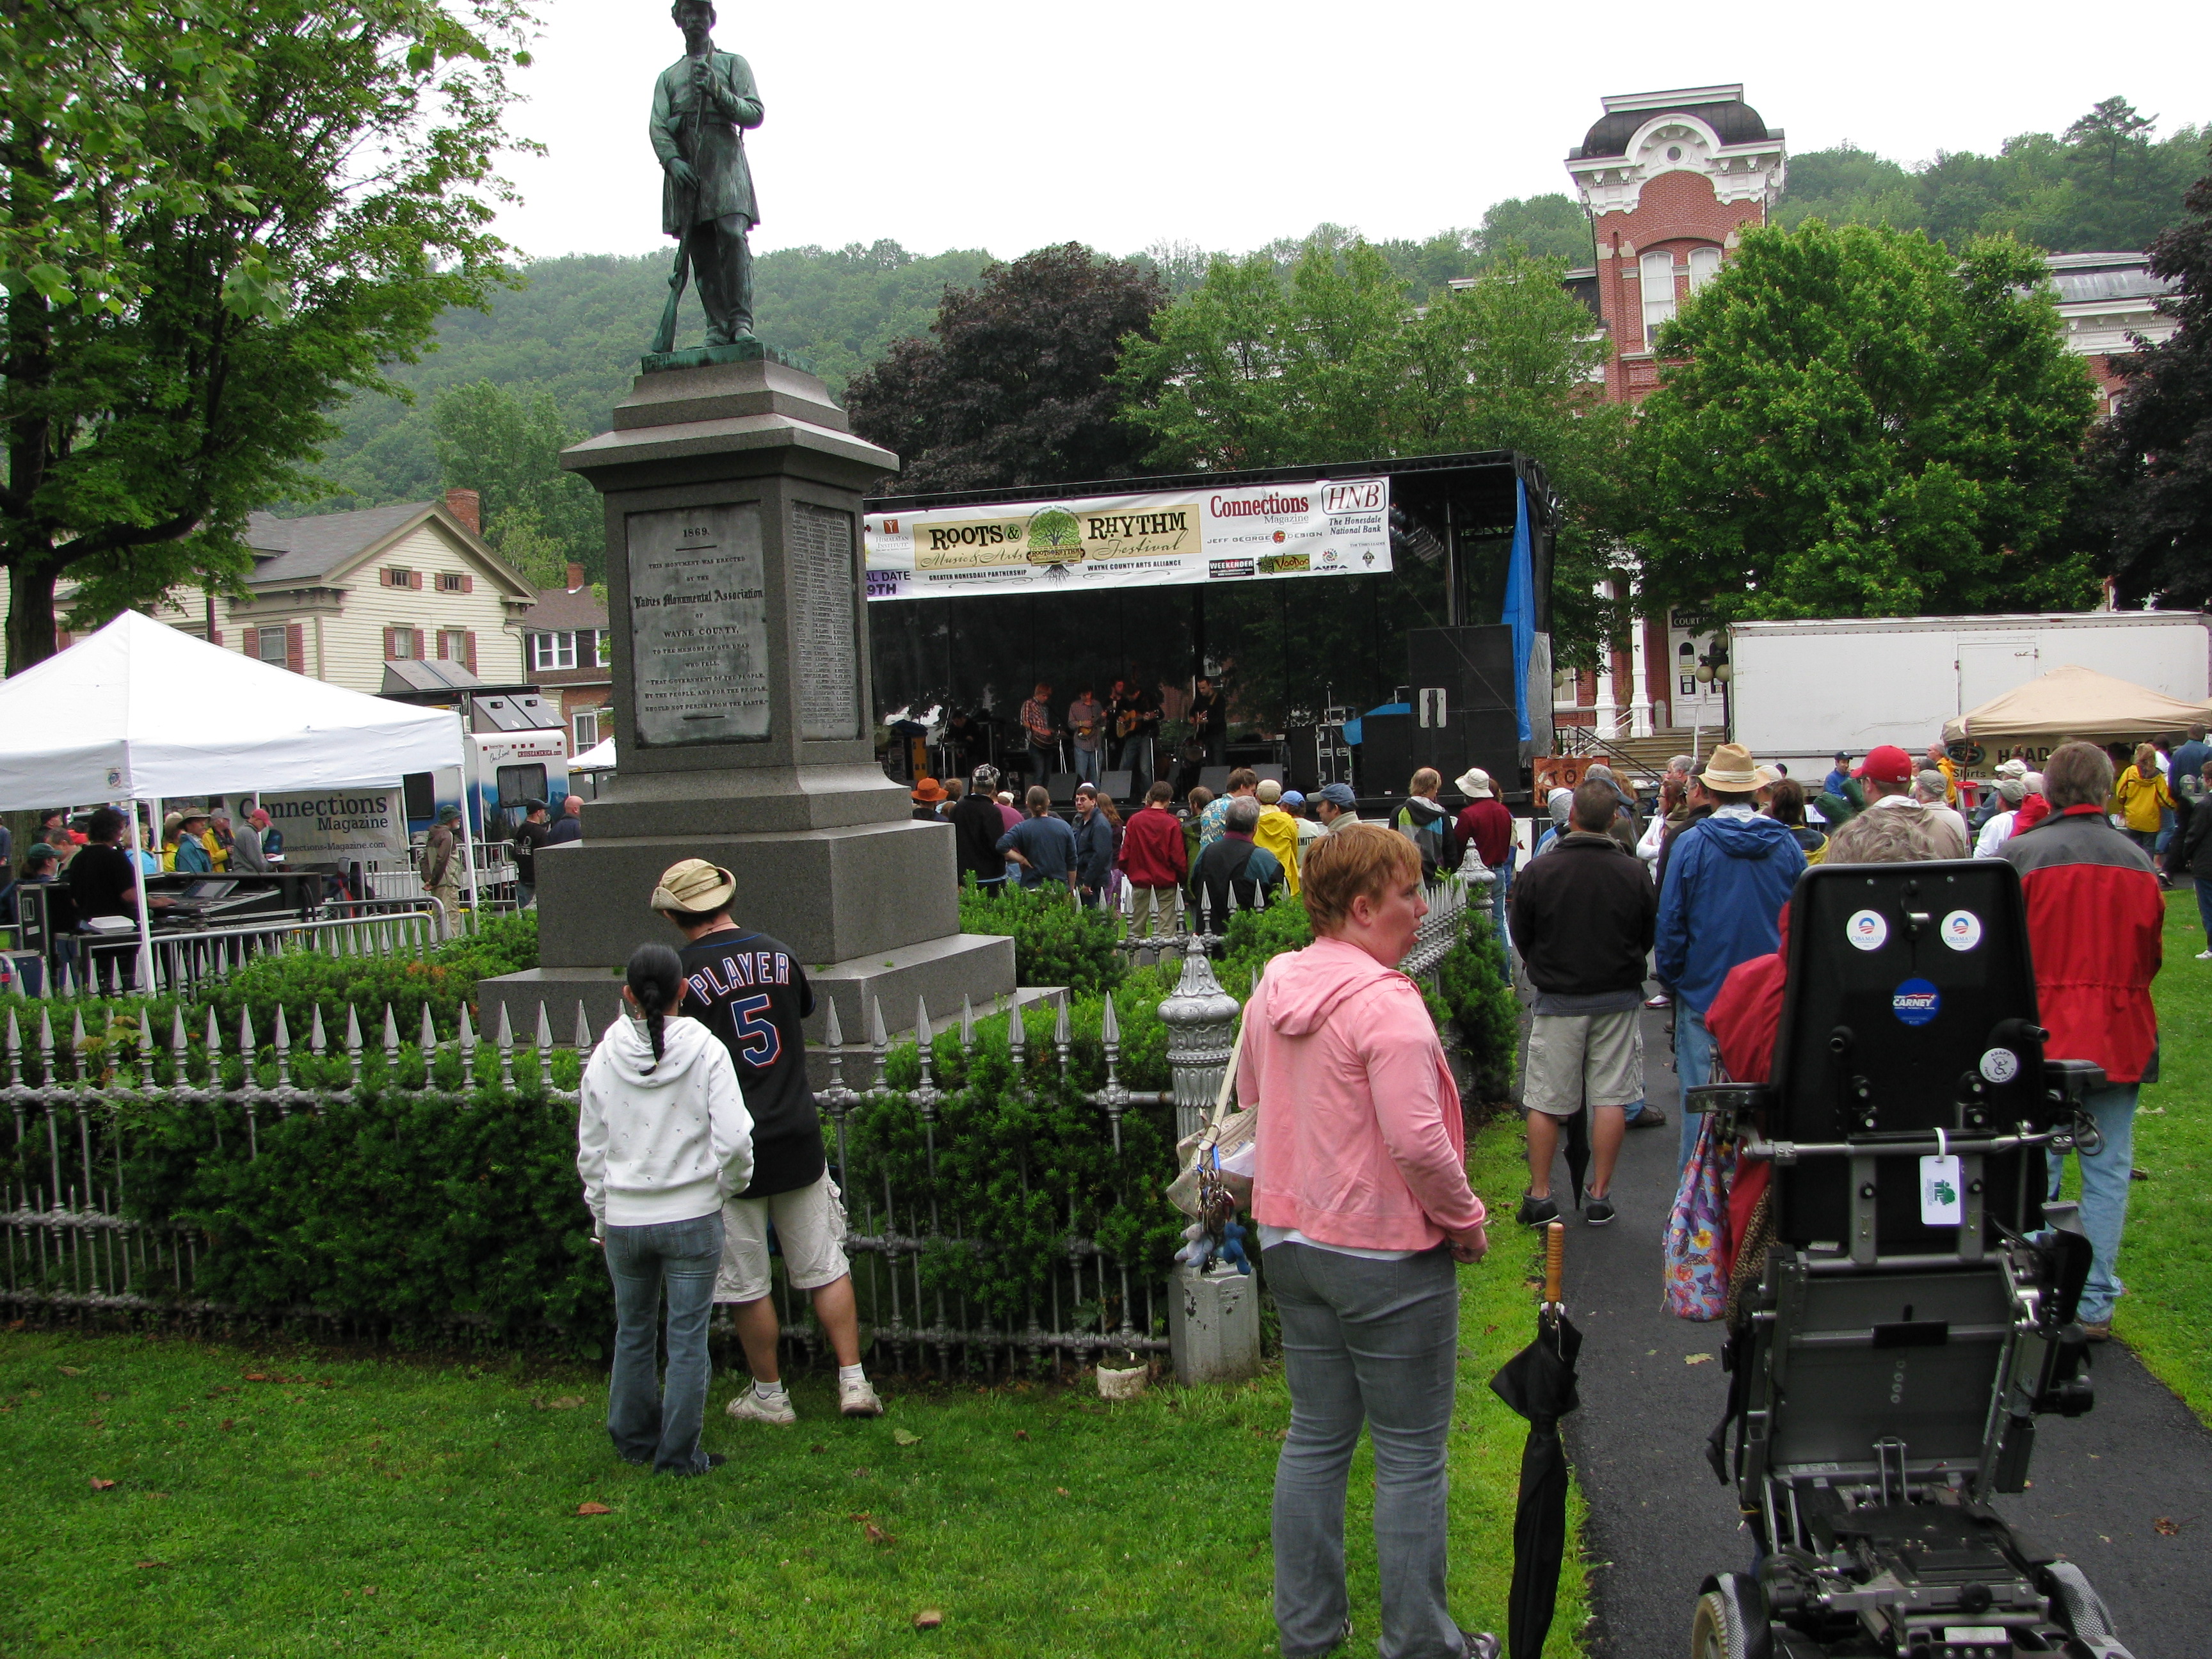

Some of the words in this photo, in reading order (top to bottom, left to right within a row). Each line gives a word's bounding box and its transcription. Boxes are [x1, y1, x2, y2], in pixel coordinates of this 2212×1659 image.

[1327, 485, 1379, 510] HNB
[1210, 492, 1309, 518] Connections
[1264, 513, 1309, 525] Magazine
[1329, 518, 1342, 526] The
[1344, 515, 1381, 525] Honesdale
[929, 525, 1004, 551] ROOTS
[1007, 526, 1021, 540] &
[1087, 512, 1186, 540] RHYTHM
[1330, 526, 1361, 535] National
[1363, 525, 1381, 533] Bank
[920, 552, 968, 568] Music
[980, 548, 1023, 563] Arts
[1093, 529, 1189, 561] Festival
[665, 560, 699, 569] MONUMENT
[1210, 560, 1253, 569] WEEKENDER
[882, 571, 911, 581] DATE
[955, 572, 986, 580] HONESDALE
[988, 569, 1027, 578] PARTNERSHIP
[663, 590, 712, 607] Monumental
[714, 588, 764, 603] Association
[1674, 617, 1699, 626] COURT
[663, 629, 694, 639] WAYNE
[669, 677, 712, 685] GOVERNMENT
[239, 793, 388, 819] Connections
[317, 815, 388, 833] Magazine
[688, 951, 790, 1006] PLAYER
[1893, 998, 1932, 1007] CARNEY
[731, 993, 783, 1068] 5
